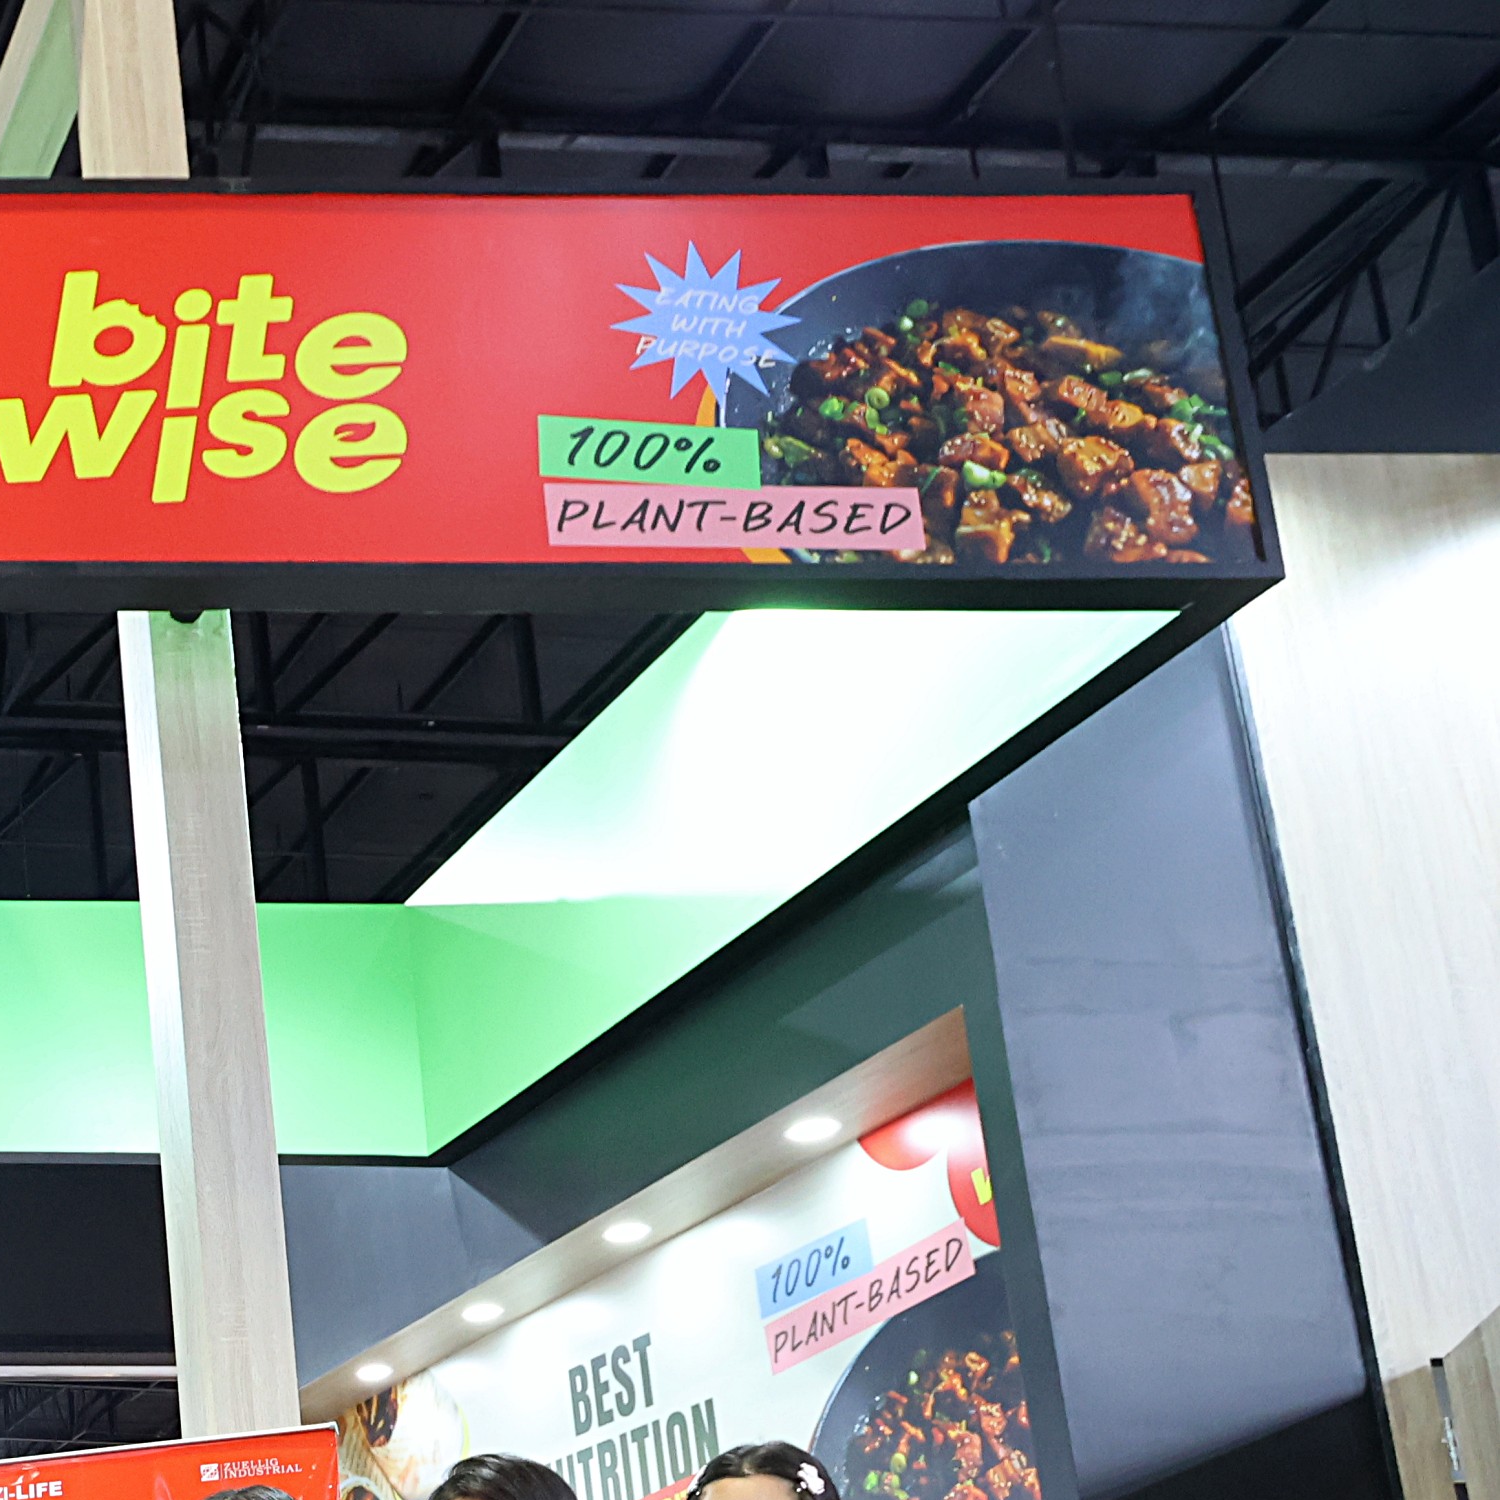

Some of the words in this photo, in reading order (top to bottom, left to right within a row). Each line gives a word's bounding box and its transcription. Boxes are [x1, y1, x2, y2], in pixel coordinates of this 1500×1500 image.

[655, 286, 760, 316] EATING
[48, 270, 408, 409] bite
[671, 317, 747, 339] WITH
[635, 335, 778, 369] PURPOSE
[567, 425, 723, 475] 100%
[556, 498, 913, 536] PLANT-BASED
[770, 1236, 850, 1303] 100%
[773, 1238, 964, 1364] PLANT-BASED
[568, 1332, 654, 1436] BEST
[223, 1457, 279, 1471] ZUELLIG
[224, 1463, 302, 1479] INDUSTRIAL
